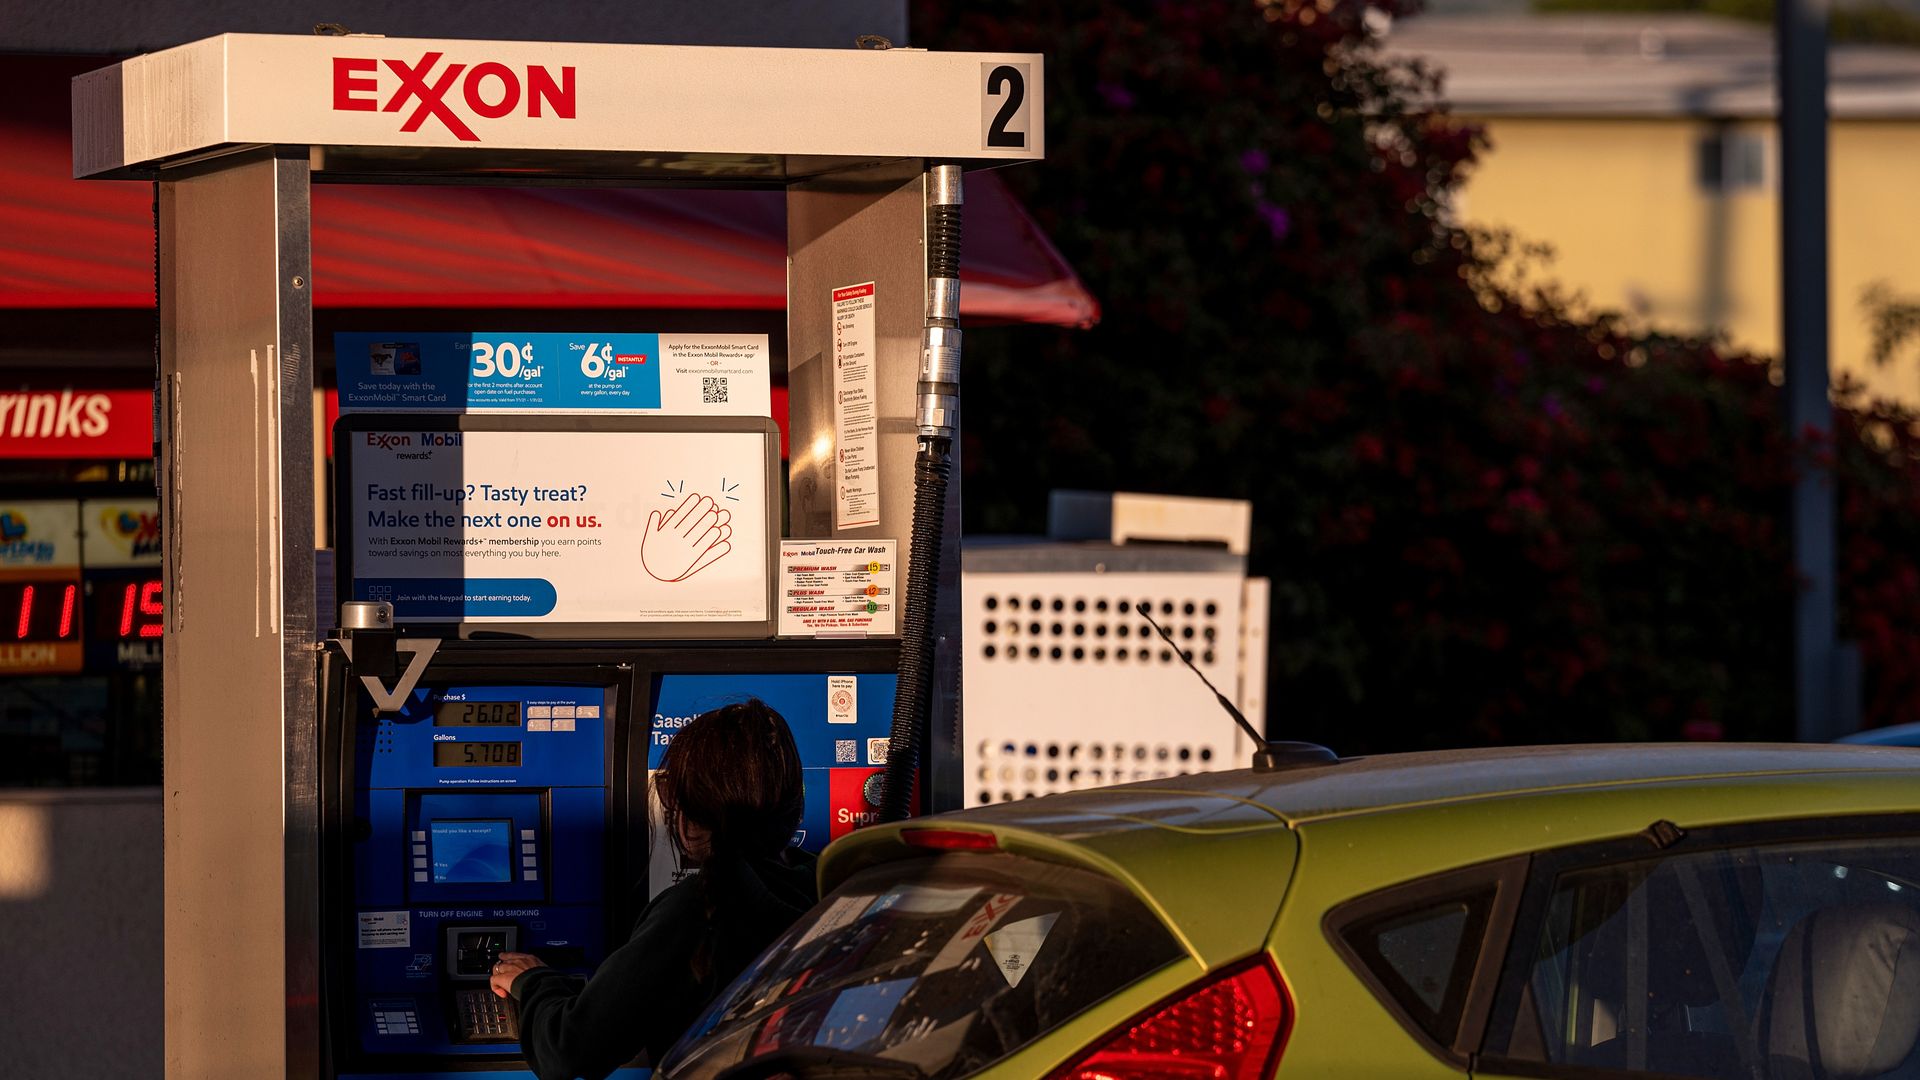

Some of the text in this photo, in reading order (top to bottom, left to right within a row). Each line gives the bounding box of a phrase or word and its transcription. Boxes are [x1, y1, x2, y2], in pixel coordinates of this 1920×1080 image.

[333, 52, 576, 141] EXXON
[987, 65, 1025, 147] 2
[455, 342, 470, 350] Earn
[569, 342, 586, 351] Save
[380, 382, 400, 392] today
[402, 382, 421, 390] with
[422, 382, 436, 390] the
[402, 393, 426, 402] Smart
[428, 393, 447, 402] Card
[367, 433, 462, 450] Exxon Mobil
[368, 484, 587, 506] Fast fill-up? Tasty treat?
[368, 511, 602, 528] Make the next one on us.
[368, 537, 389, 545] With
[390, 537, 415, 545] Exxon
[418, 537, 441, 545] Mobil
[489, 537, 539, 547] membership
[541, 539, 556, 547] you
[577, 537, 602, 547] points
[400, 549, 429, 558] savings
[464, 549, 506, 559] everything
[508, 551, 524, 559] you
[525, 549, 539, 559] buy
[815, 547, 853, 555] Touch-Free
[854, 546, 866, 554] Car
[867, 546, 886, 554] Wash
[439, 594, 463, 603] keypad
[488, 595, 512, 603] earning
[513, 594, 532, 603] today.
[462, 694, 466, 702] $
[463, 704, 516, 723] 26.02
[653, 713, 701, 729] Gaso
[651, 731, 674, 745] Ta
[464, 744, 518, 763] 5.708
[838, 808, 878, 827] Supr
[506, 909, 540, 917] SMOKING
